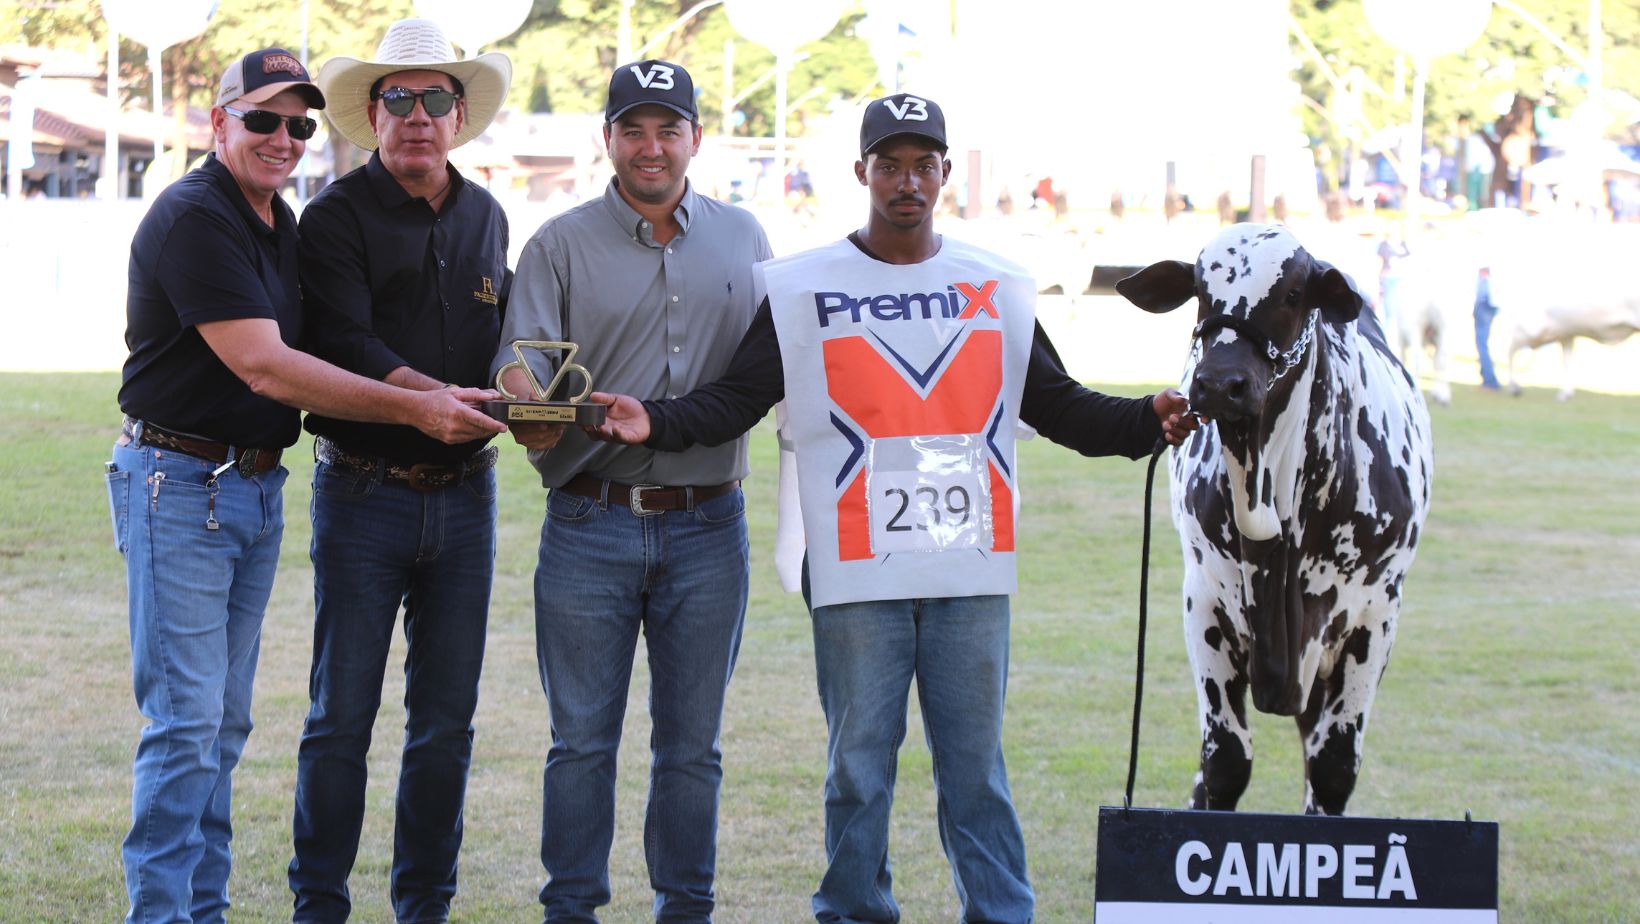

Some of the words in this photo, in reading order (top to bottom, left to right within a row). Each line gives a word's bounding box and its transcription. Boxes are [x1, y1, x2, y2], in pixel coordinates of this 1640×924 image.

[630, 64, 674, 90] V3
[883, 96, 928, 121] V3
[885, 485, 971, 532] 239
[1175, 832, 1418, 901] CAMPEÃ
